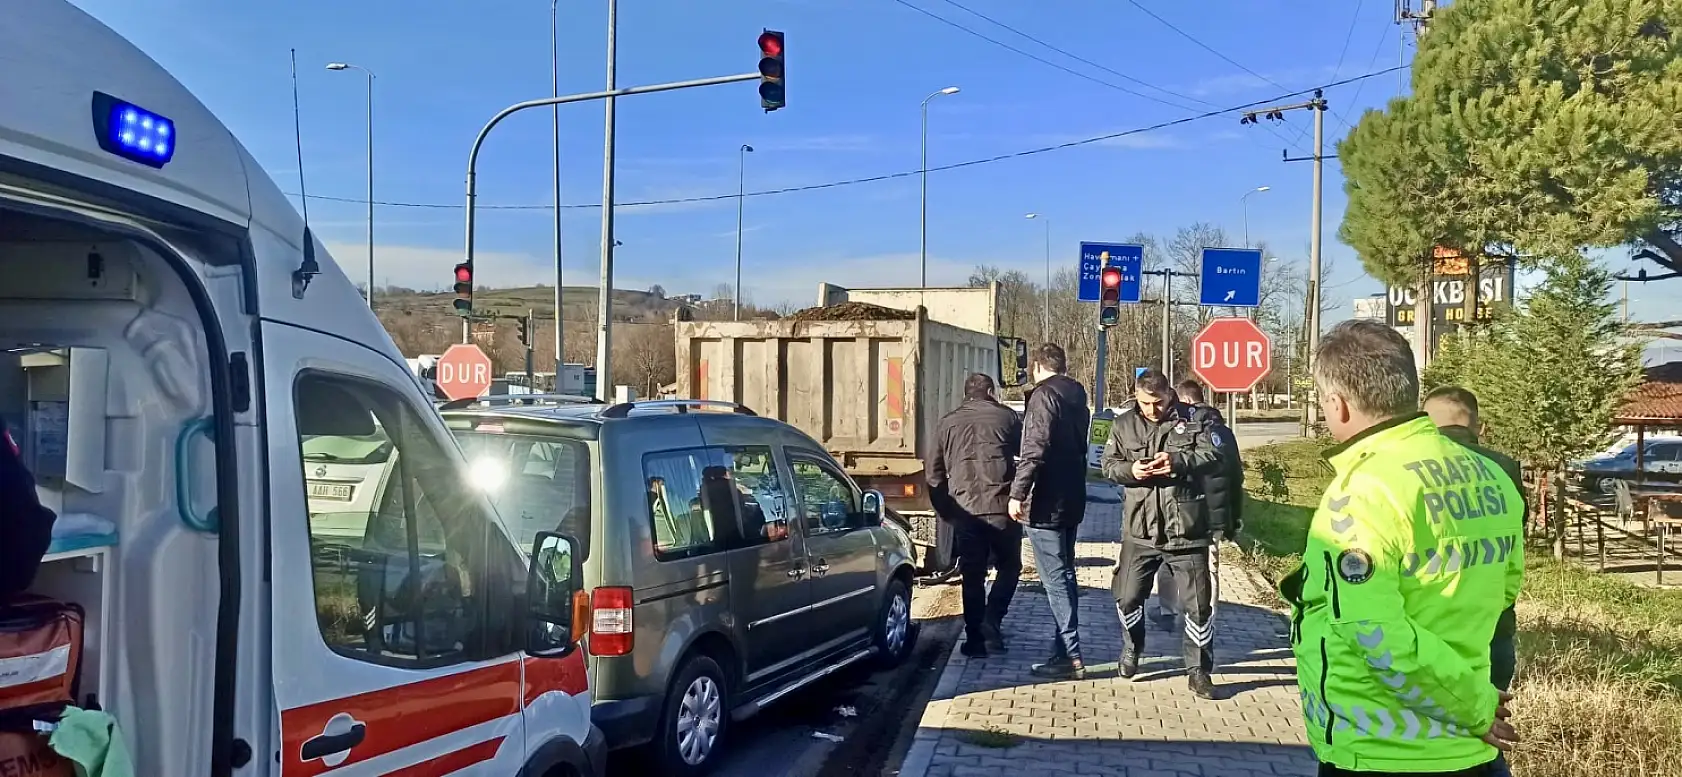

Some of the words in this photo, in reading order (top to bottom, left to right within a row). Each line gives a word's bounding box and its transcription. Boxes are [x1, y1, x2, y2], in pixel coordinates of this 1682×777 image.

[1445, 307, 1493, 321] HOSE
[1200, 341, 1263, 368] DUR
[442, 362, 487, 384] DUR
[332, 486, 349, 497] 566
